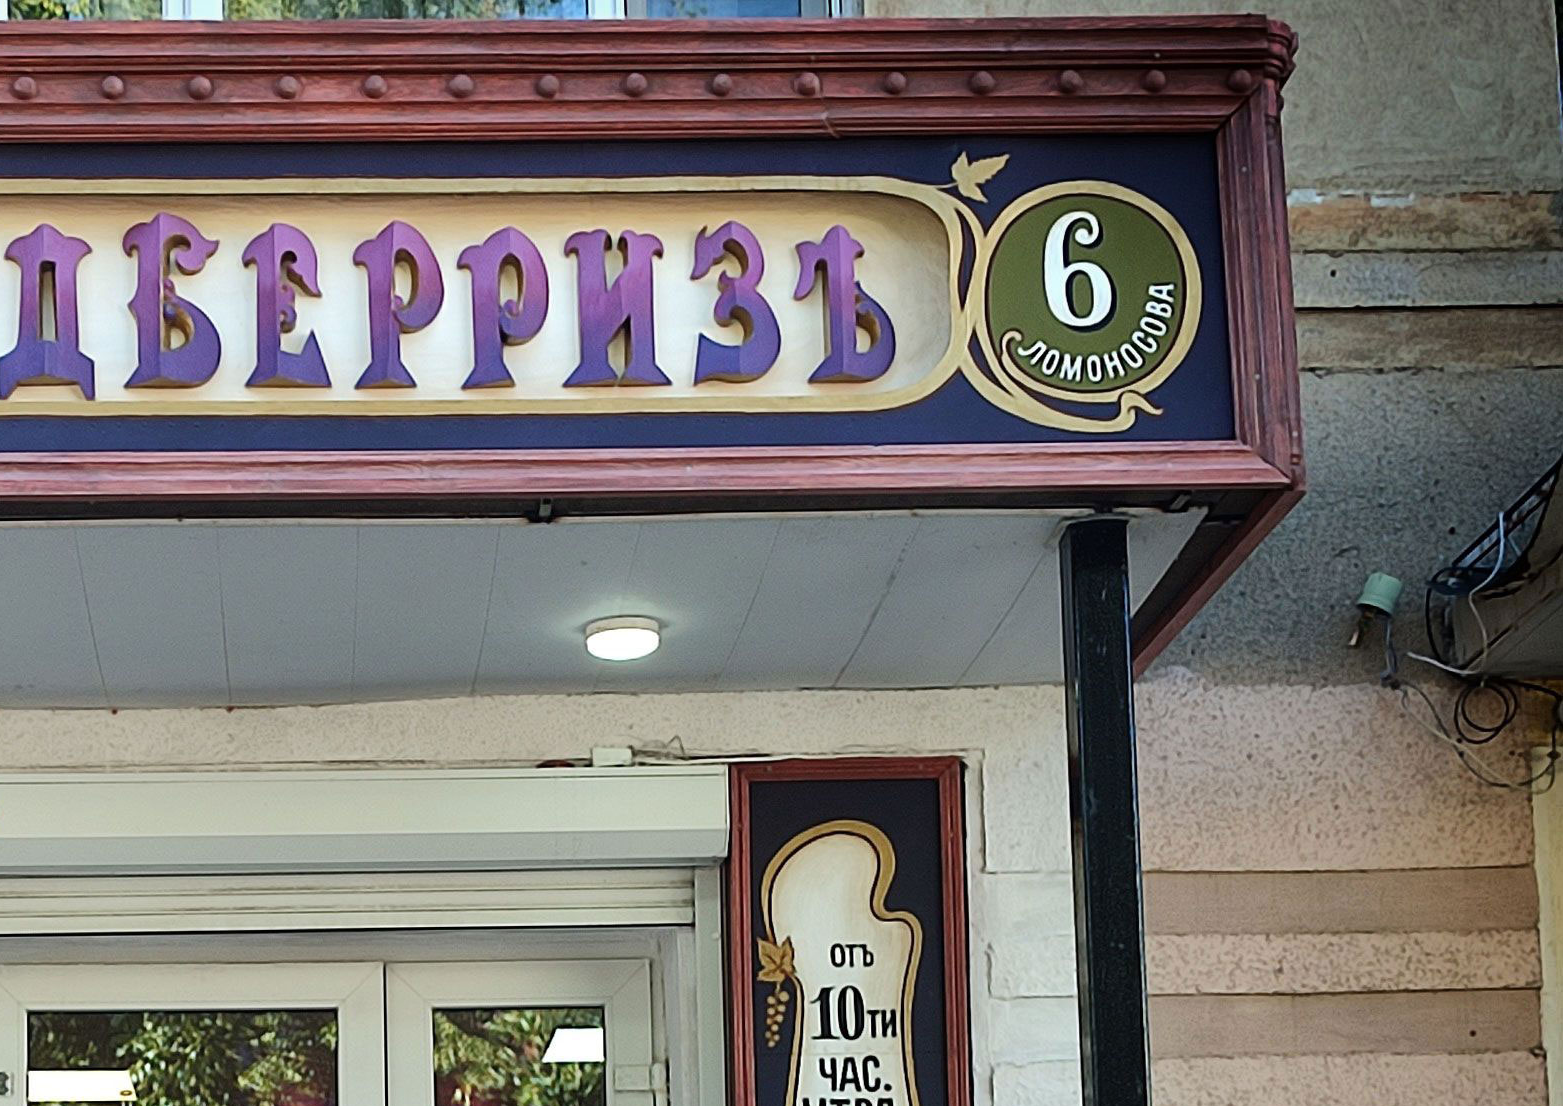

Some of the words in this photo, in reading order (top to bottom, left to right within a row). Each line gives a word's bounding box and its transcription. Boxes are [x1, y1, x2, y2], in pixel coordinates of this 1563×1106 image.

[1044, 211, 1113, 327] 6
[1017, 283, 1175, 382] ЛОМОНОСОВА
[819, 1055, 892, 1092] ЧАС.
